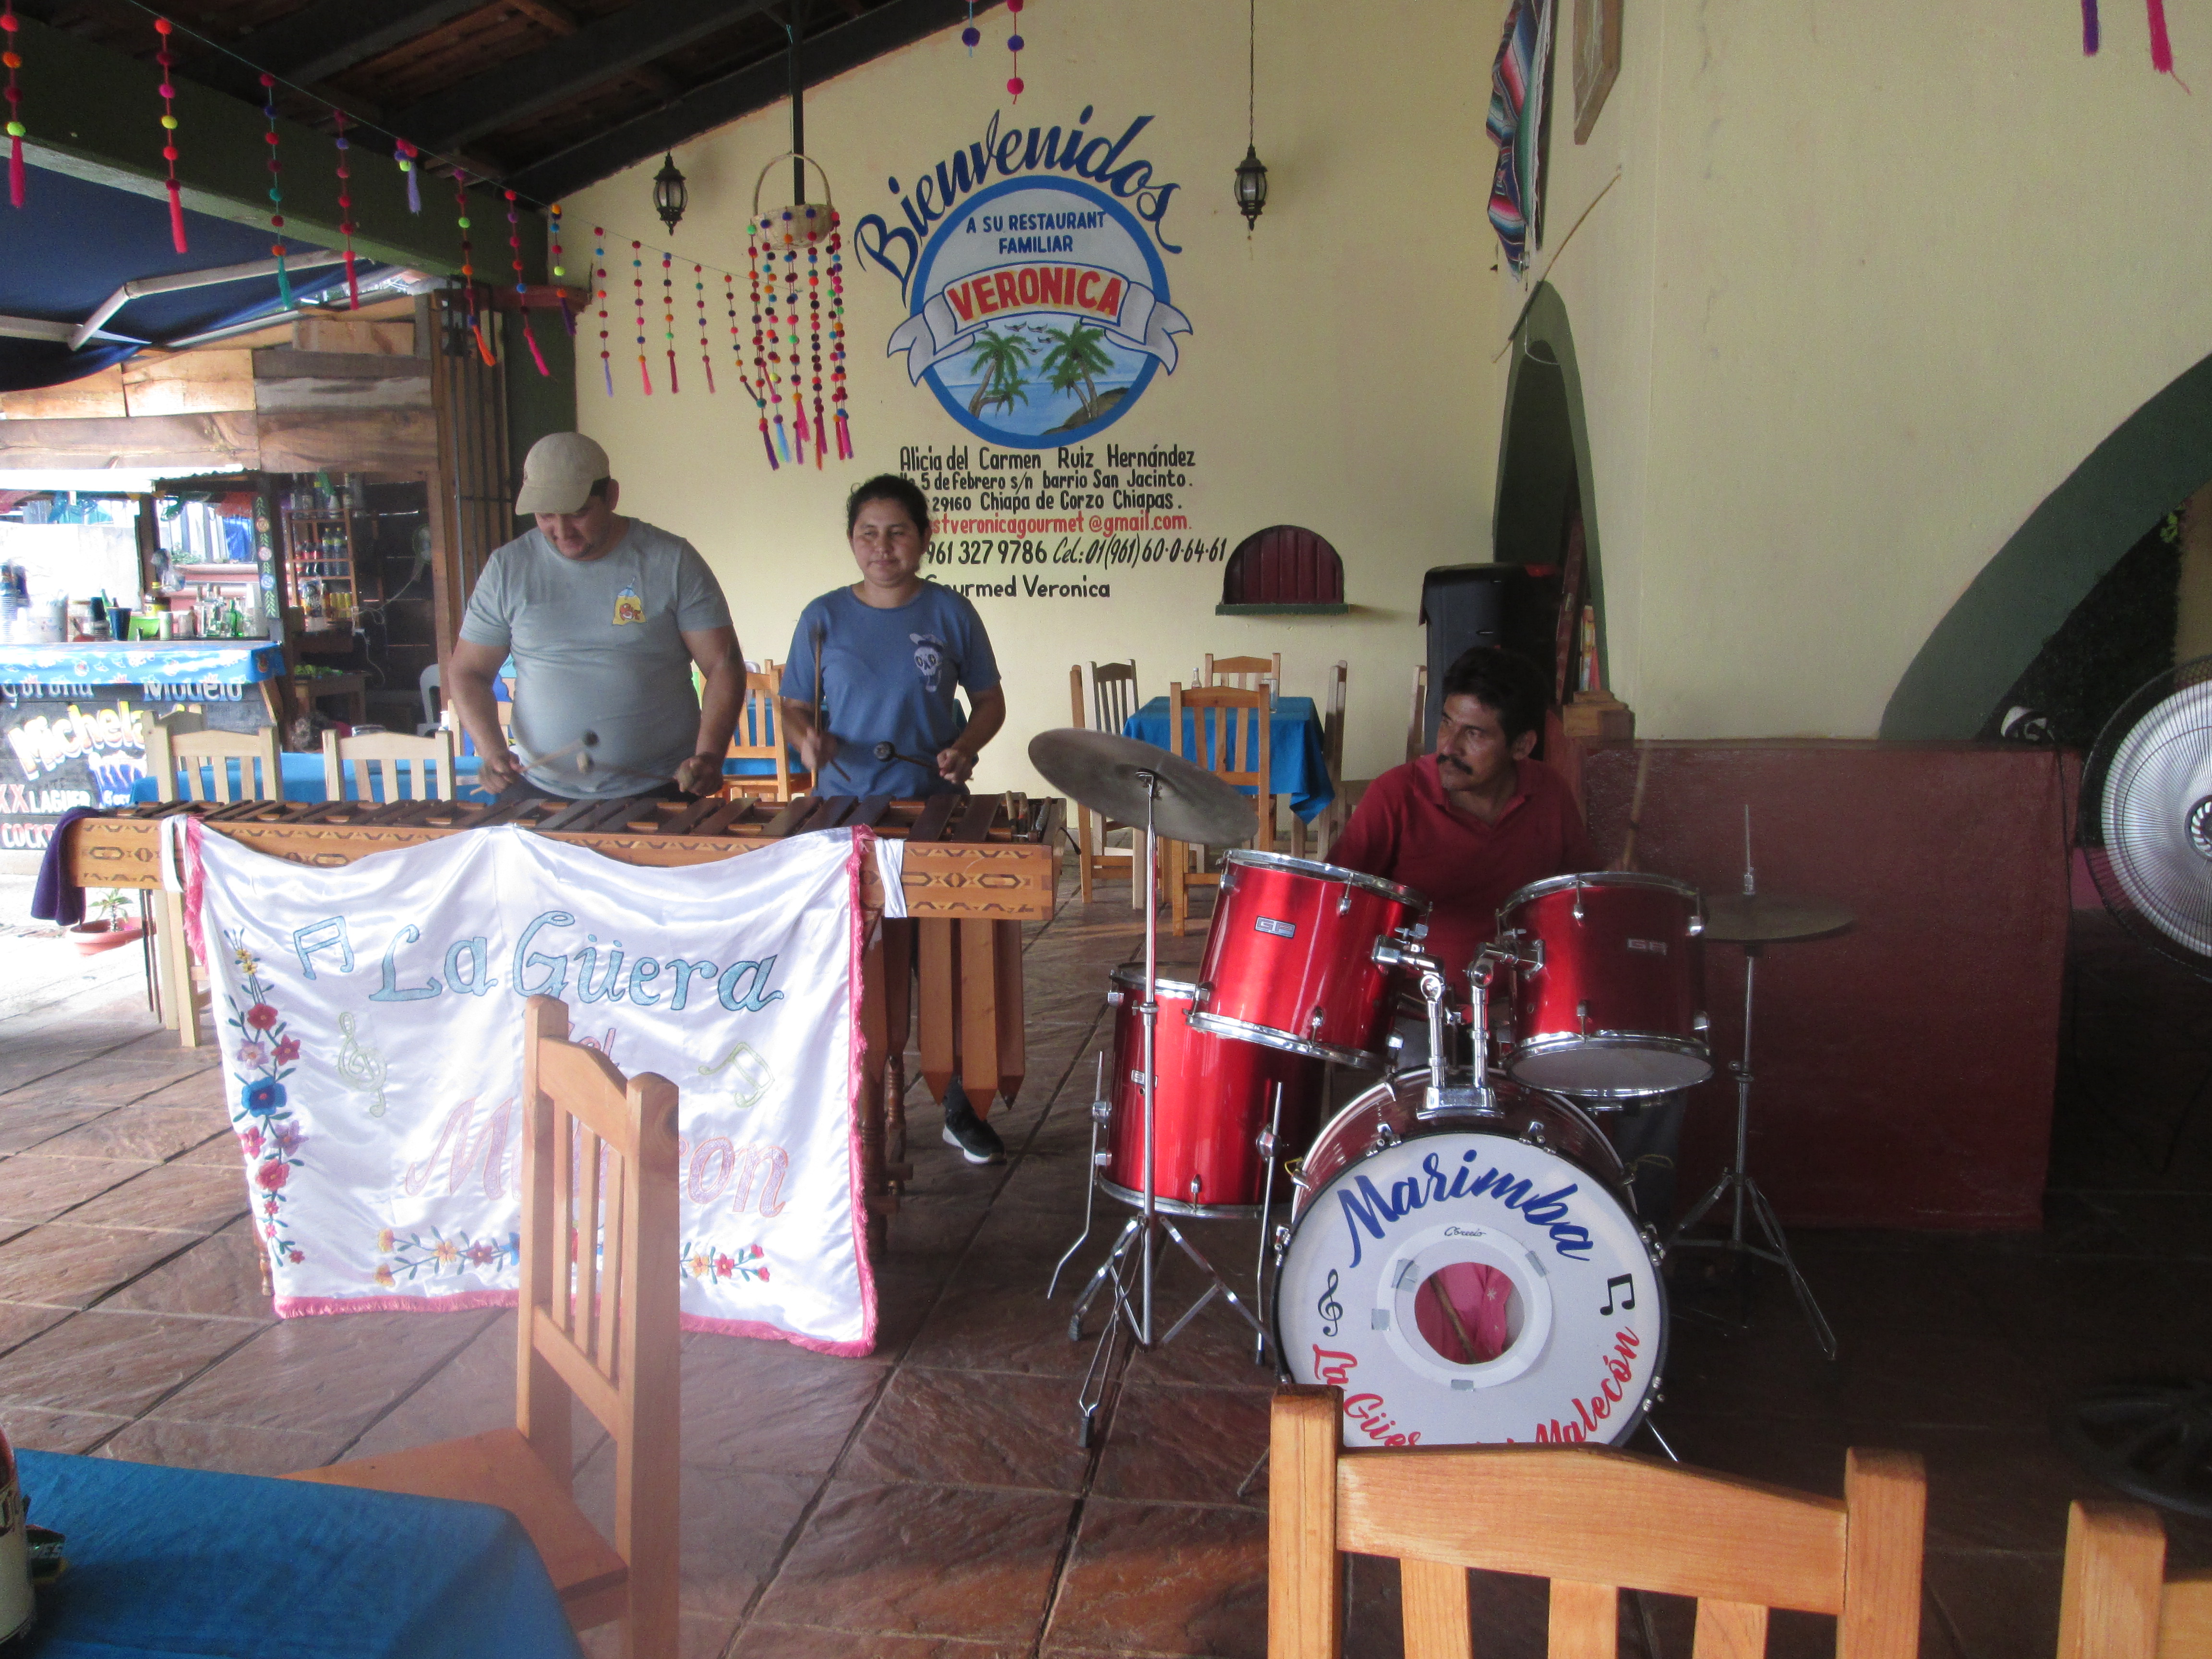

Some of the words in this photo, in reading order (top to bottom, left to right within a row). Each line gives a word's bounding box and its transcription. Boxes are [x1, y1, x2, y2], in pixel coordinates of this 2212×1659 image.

[854, 105, 1182, 309] Bienvenidos
[966, 217, 976, 234] A
[983, 216, 1003, 233] SU
[1009, 211, 1106, 231] RESTAURANT
[999, 235, 1073, 254] FAMILIAR
[946, 267, 1122, 321] VERONICA
[900, 445, 942, 471] Alicia
[947, 445, 968, 470] del
[979, 447, 1041, 470] Carmen
[1058, 445, 1094, 469] Ruiz
[1107, 444, 1196, 468] Hernández
[921, 472, 931, 490] 5
[934, 471, 950, 490] de
[1010, 471, 1033, 495] s/n
[1043, 469, 1087, 489] barrio
[1093, 469, 1119, 489] San
[932, 496, 972, 512] 29160
[980, 492, 1030, 515] Chiapa
[1036, 490, 1054, 510] de
[1060, 490, 1104, 510] Corzo
[958, 540, 994, 565] 327
[998, 540, 1047, 564] 9786
[1022, 575, 1110, 597] Veronica
[369, 924, 498, 1001] La
[513, 911, 784, 1012] Güera
[1337, 1149, 1594, 1269] Marimba
[1536, 1326, 1640, 1443] Malecón
